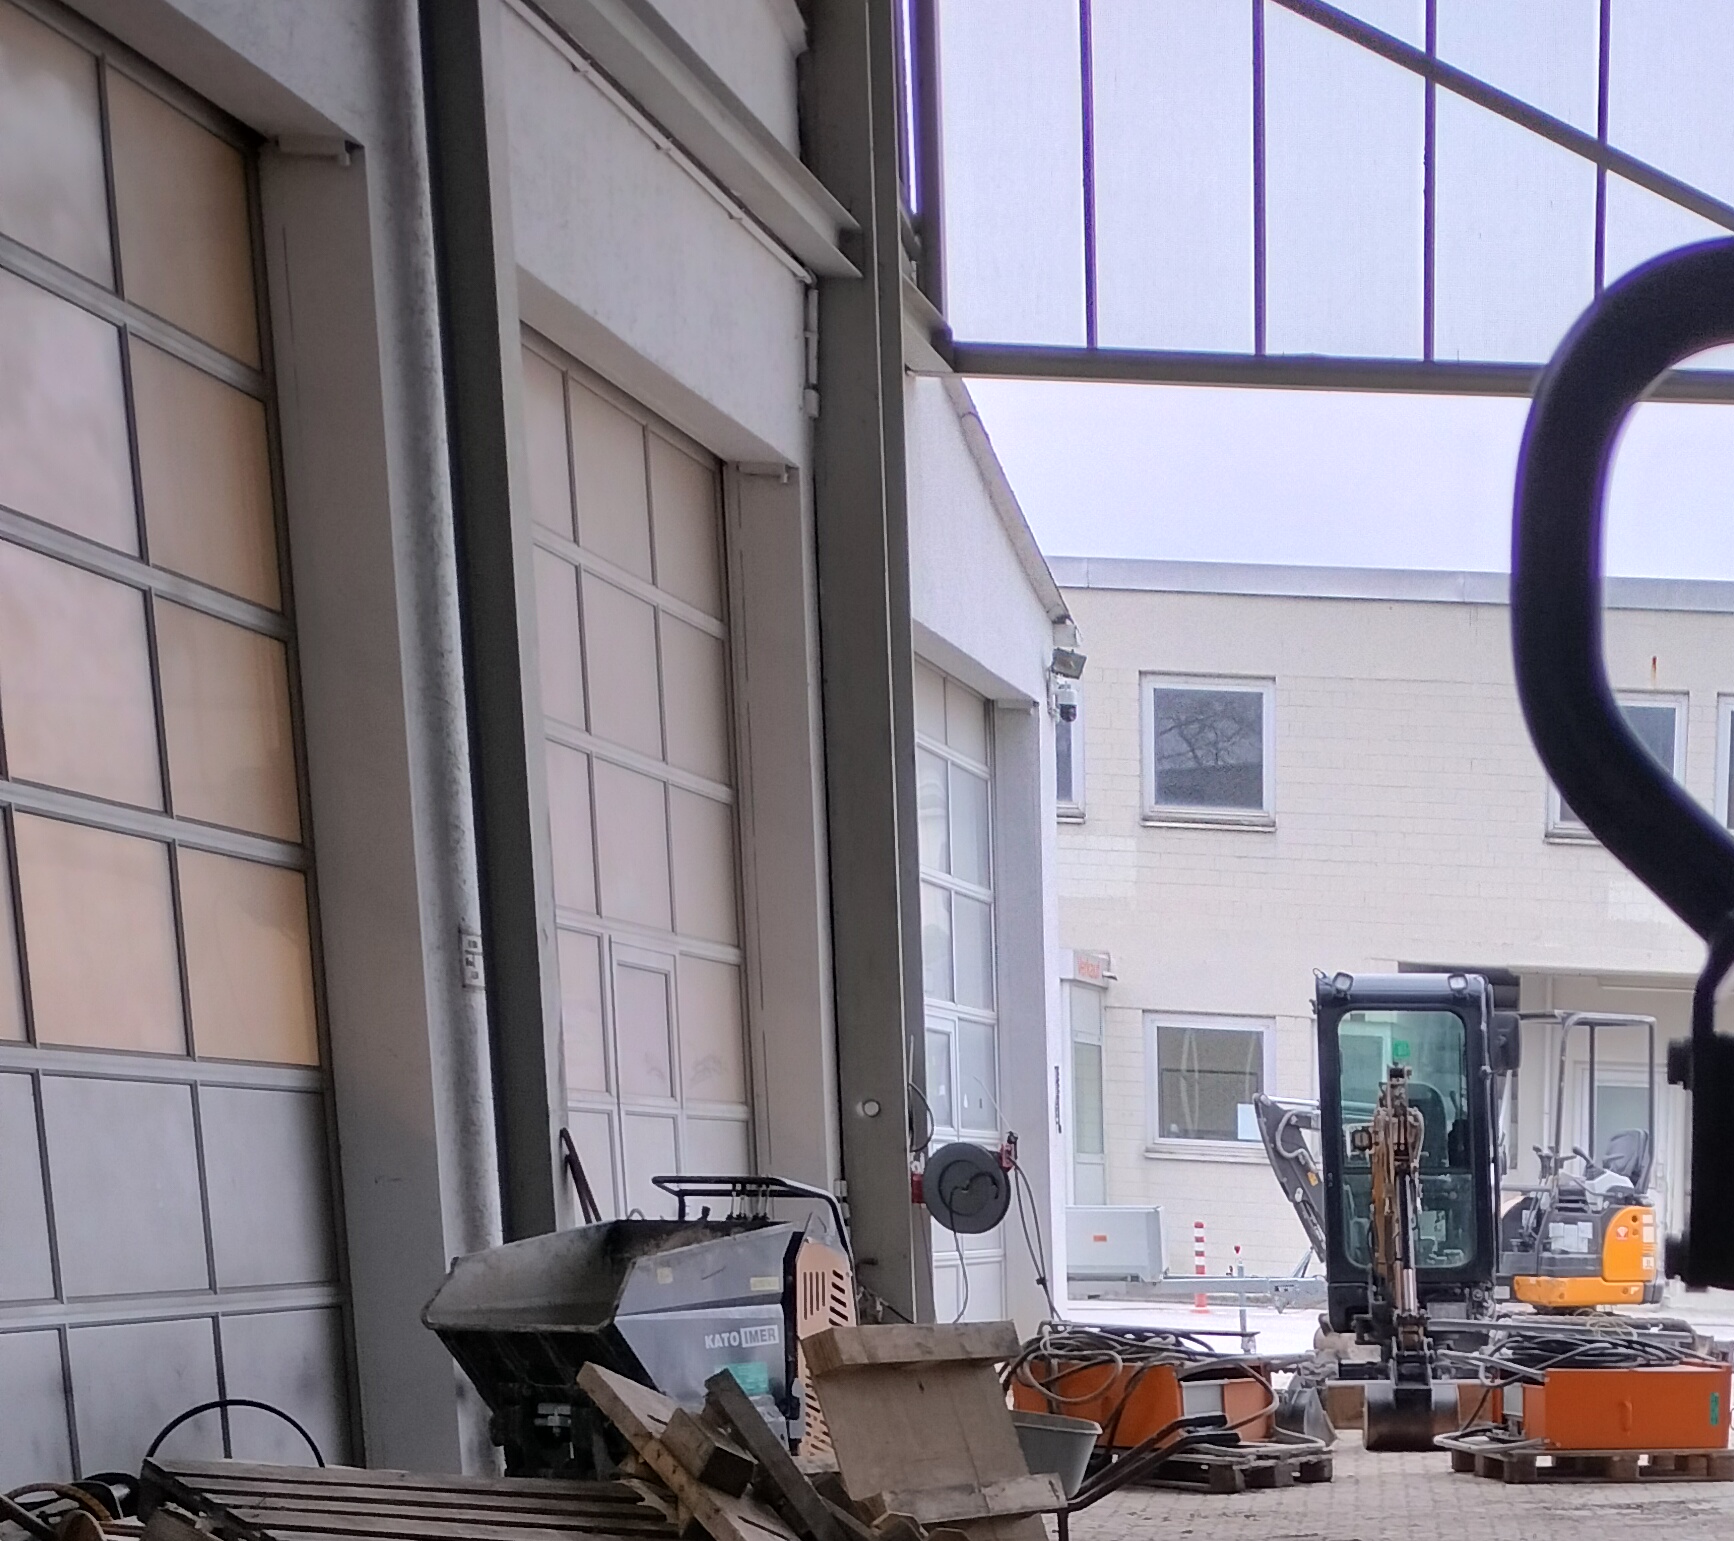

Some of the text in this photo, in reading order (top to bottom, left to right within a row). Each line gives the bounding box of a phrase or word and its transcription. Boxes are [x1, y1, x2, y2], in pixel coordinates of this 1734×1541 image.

[1076, 956, 1100, 979] Verkauf
[704, 1326, 778, 1350] KATO IMER
